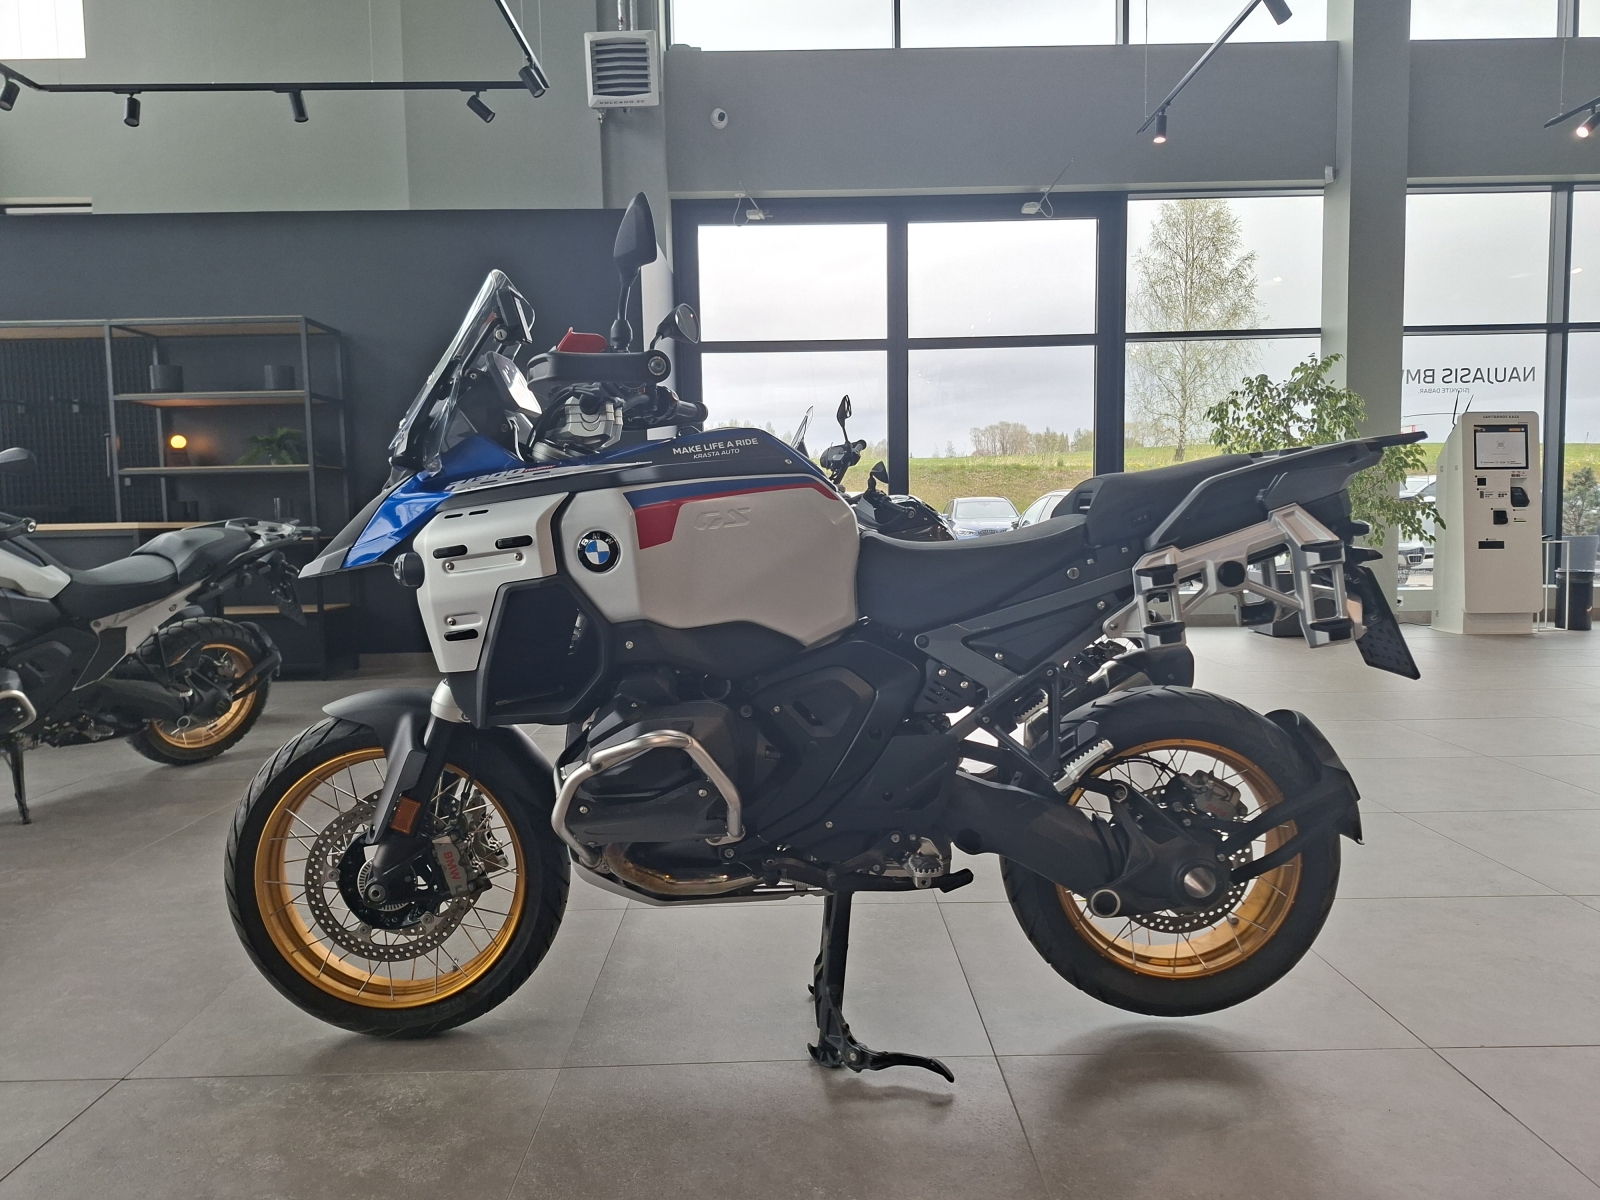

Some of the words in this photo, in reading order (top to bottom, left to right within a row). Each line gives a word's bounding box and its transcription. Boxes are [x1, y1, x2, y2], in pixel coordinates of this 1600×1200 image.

[672, 444, 702, 455] MAKE
[703, 441, 725, 451] LIFE
[726, 440, 735, 448] A
[736, 438, 759, 447] RIDE
[693, 450, 720, 459] KRASTA
[721, 448, 740, 456] AUTO
[693, 507, 752, 531] GS
[443, 850, 461, 880] BMW
